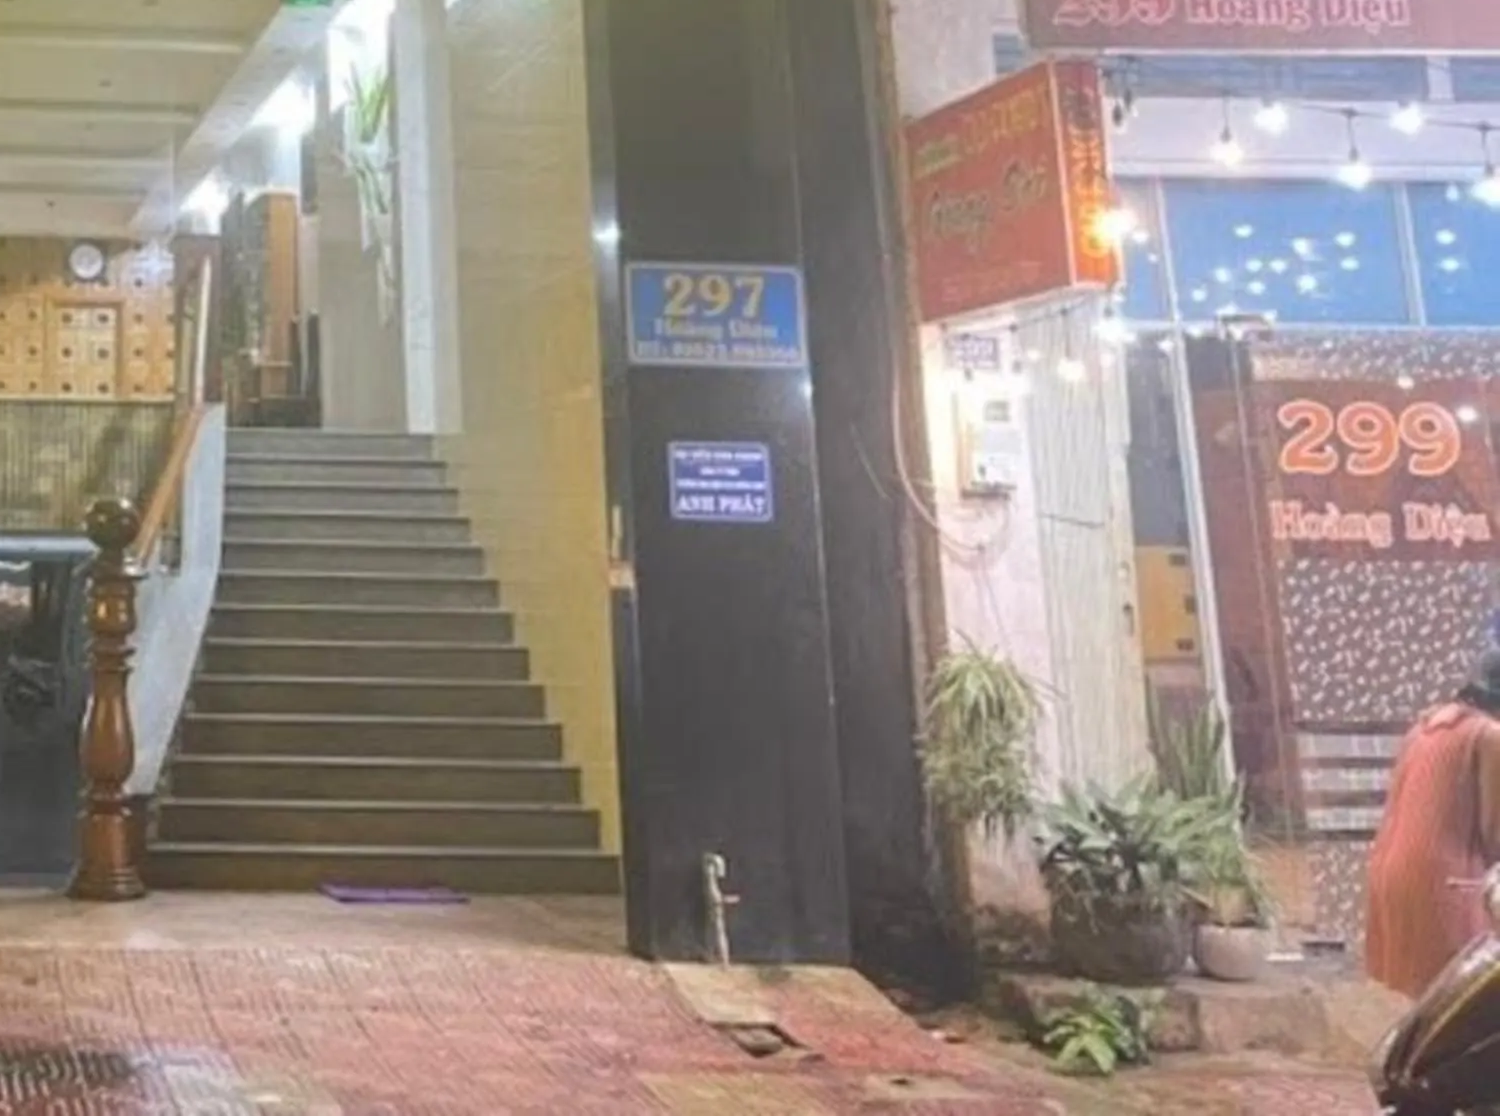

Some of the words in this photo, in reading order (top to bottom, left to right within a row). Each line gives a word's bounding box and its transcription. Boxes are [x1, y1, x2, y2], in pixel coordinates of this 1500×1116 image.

[662, 273, 765, 318] 297
[1277, 398, 1461, 477] 299
[1268, 500, 1394, 548] Hoàng
